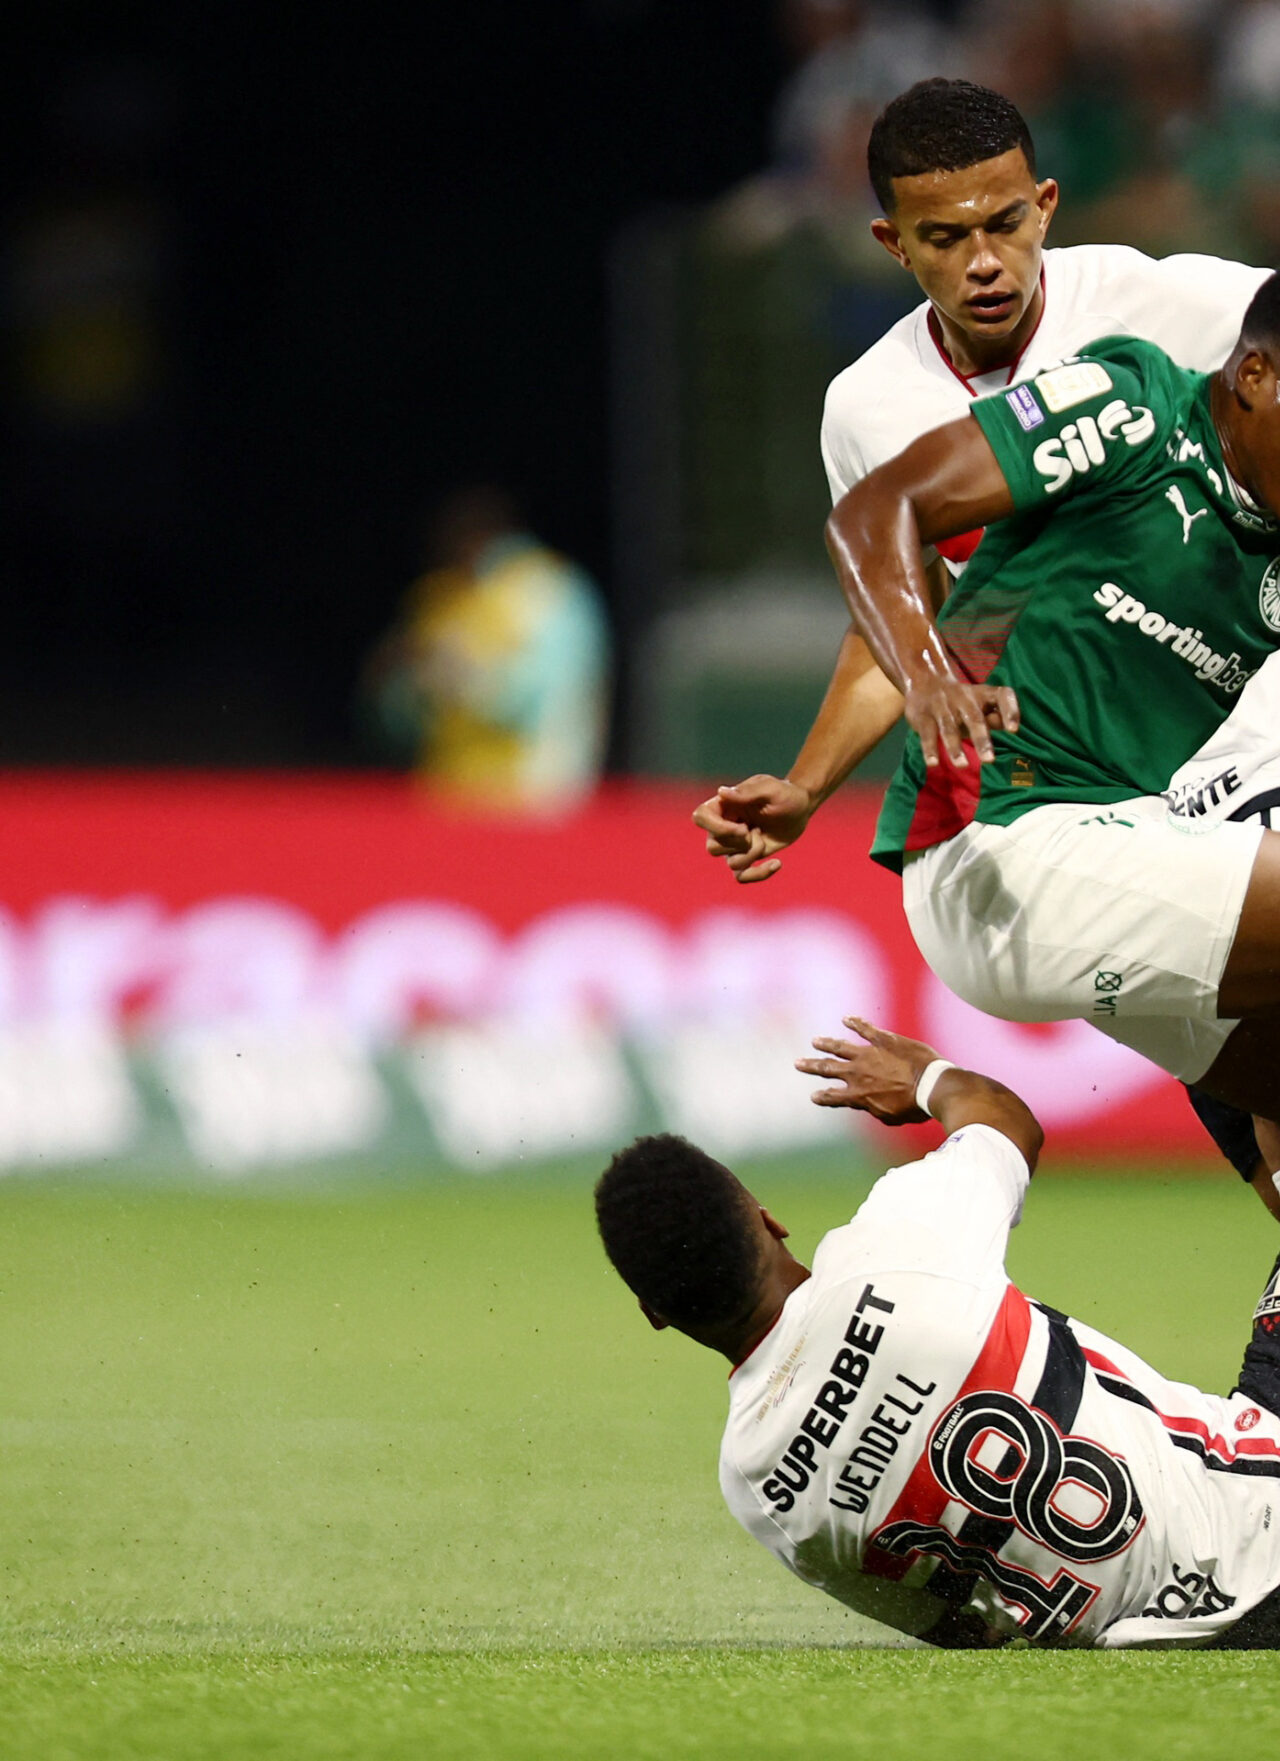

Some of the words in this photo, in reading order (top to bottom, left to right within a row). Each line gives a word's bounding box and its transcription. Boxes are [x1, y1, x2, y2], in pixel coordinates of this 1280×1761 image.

[1093, 582, 1258, 693] sportingbe
[762, 1283, 895, 1513] SUPERBET
[828, 1373, 937, 1514] WENDELL
[867, 1387, 1146, 1641] 18
